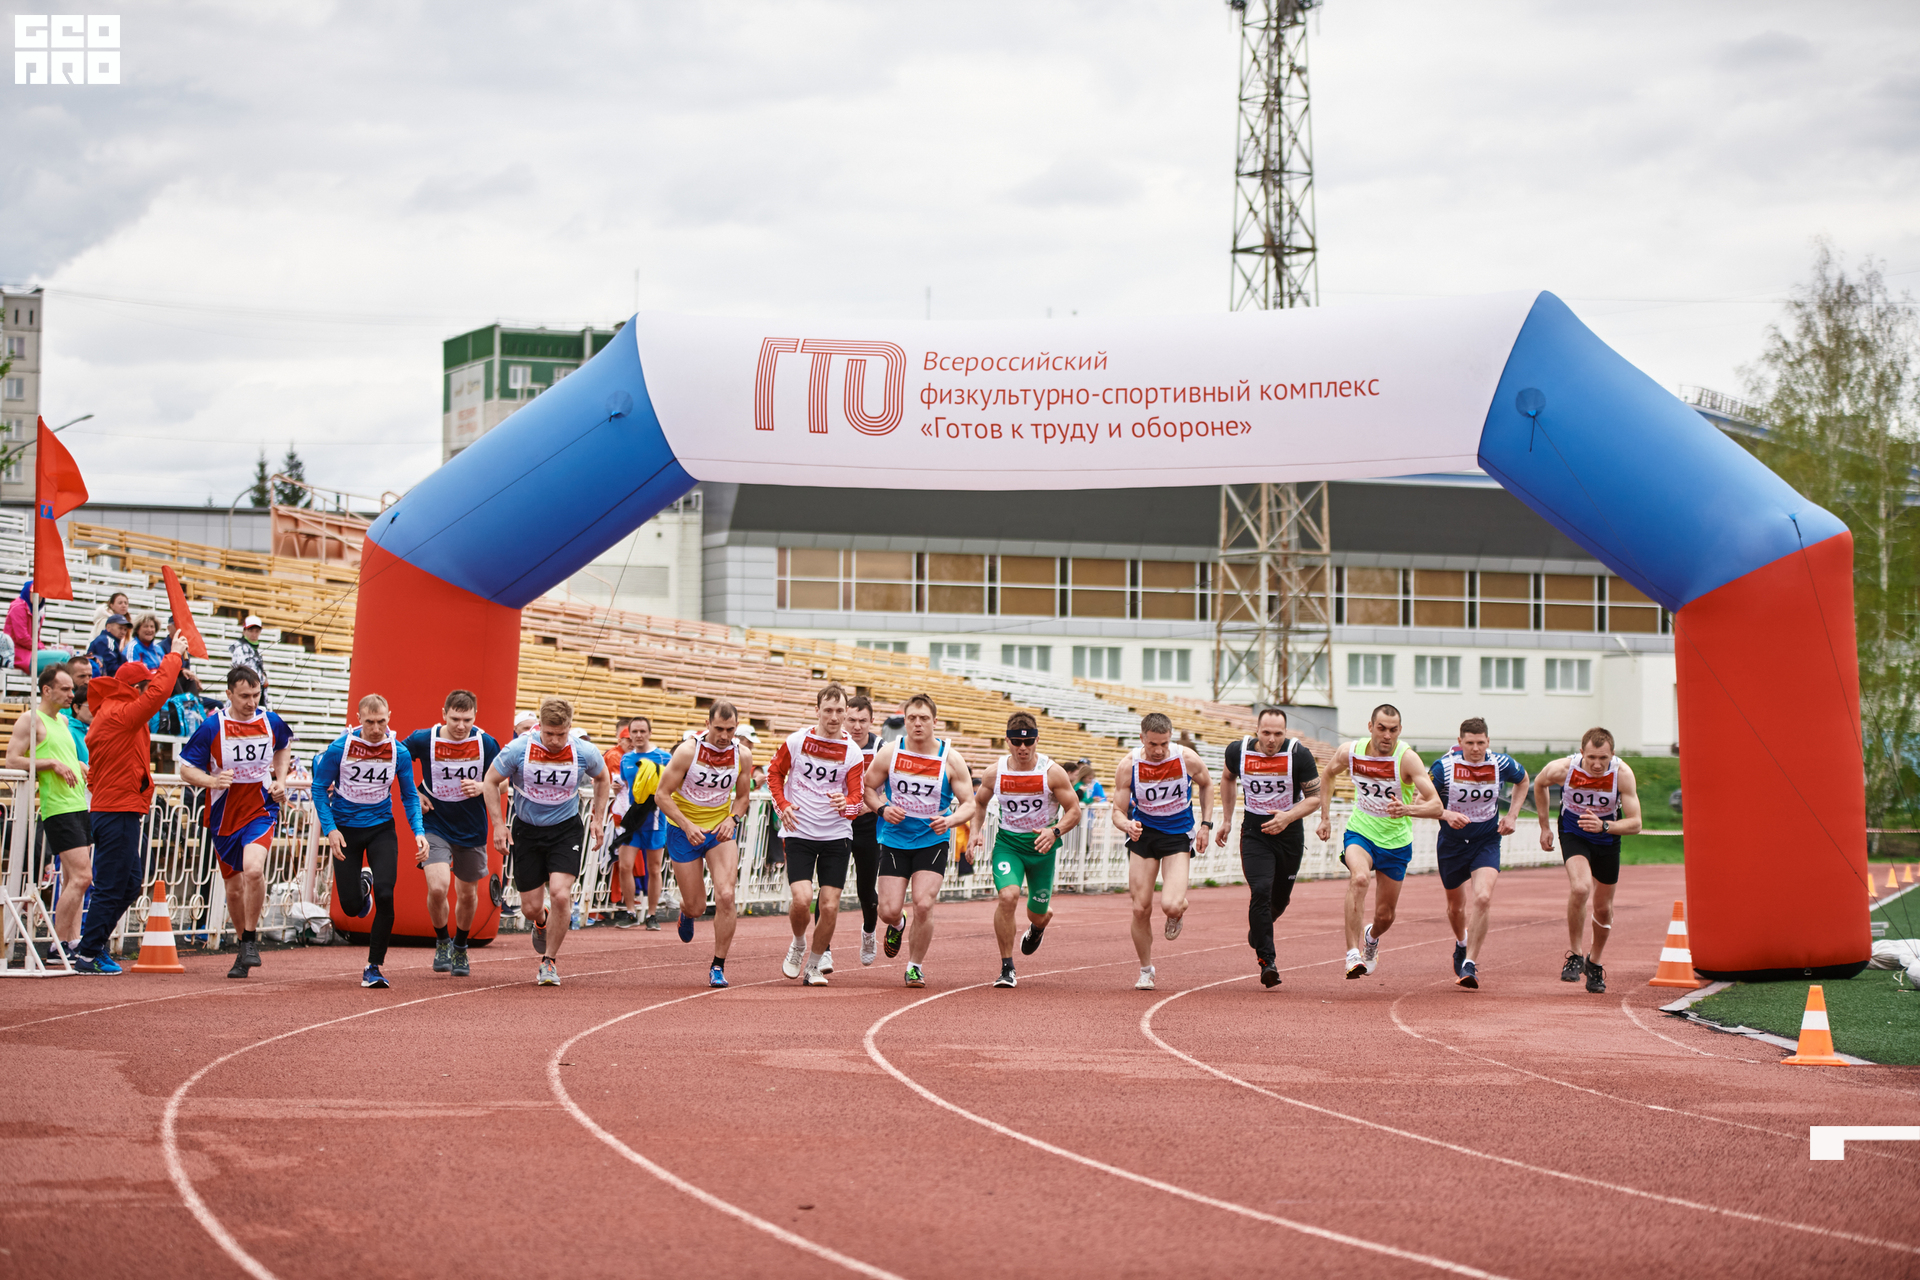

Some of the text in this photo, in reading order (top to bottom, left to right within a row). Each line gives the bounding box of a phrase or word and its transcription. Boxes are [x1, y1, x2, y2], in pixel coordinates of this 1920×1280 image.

[923, 351, 1108, 377] Всероссийский
[754, 337, 907, 436] ГТО
[920, 378, 1380, 411] физкультурно-спортивный комплекс
[920, 415, 1252, 445] «Готов к труду и обороне»
[232, 743, 268, 762] 187
[349, 765, 389, 785] 244
[441, 765, 478, 781] 140
[533, 769, 572, 787] 147
[694, 771, 732, 790] 230
[803, 762, 838, 783] 291
[896, 780, 935, 797] 027
[1145, 784, 1184, 802] 074
[1249, 780, 1287, 795] 035
[1358, 781, 1396, 800] 326
[1456, 788, 1494, 804] 299
[1006, 798, 1044, 814] 059
[1572, 792, 1610, 809] 019
[998, 861, 1011, 875] 9
